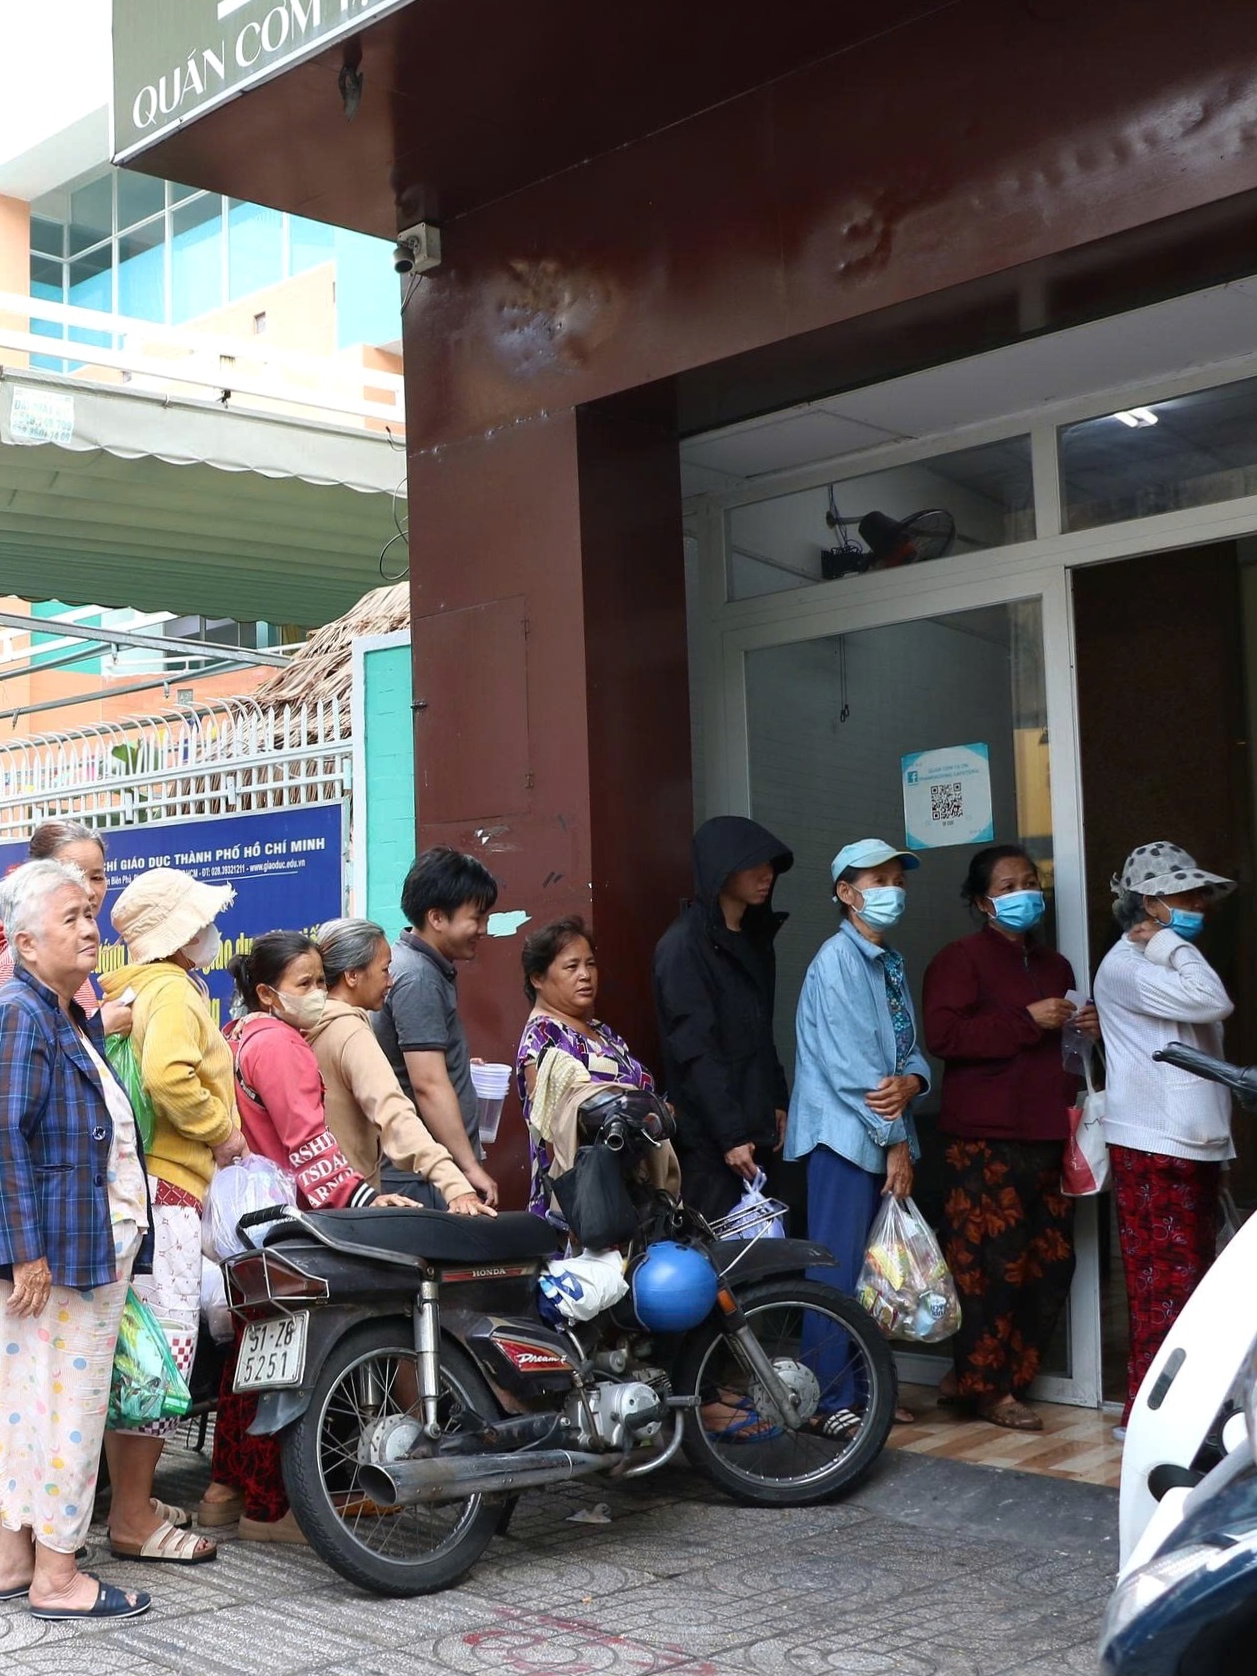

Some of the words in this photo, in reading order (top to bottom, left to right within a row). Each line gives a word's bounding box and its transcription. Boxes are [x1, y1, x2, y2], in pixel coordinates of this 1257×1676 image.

[132, 40, 225, 128] QUÁN
[120, 855, 145, 870] GIÁO
[174, 850, 212, 865] THÀNH
[215, 843, 241, 860] PHỐ
[264, 839, 287, 855] CHÍ
[290, 837, 325, 853] MINH
[472, 1268, 506, 1278] HONDA
[244, 1351, 288, 1382] 5251
[516, 1353, 559, 1364] Dream
